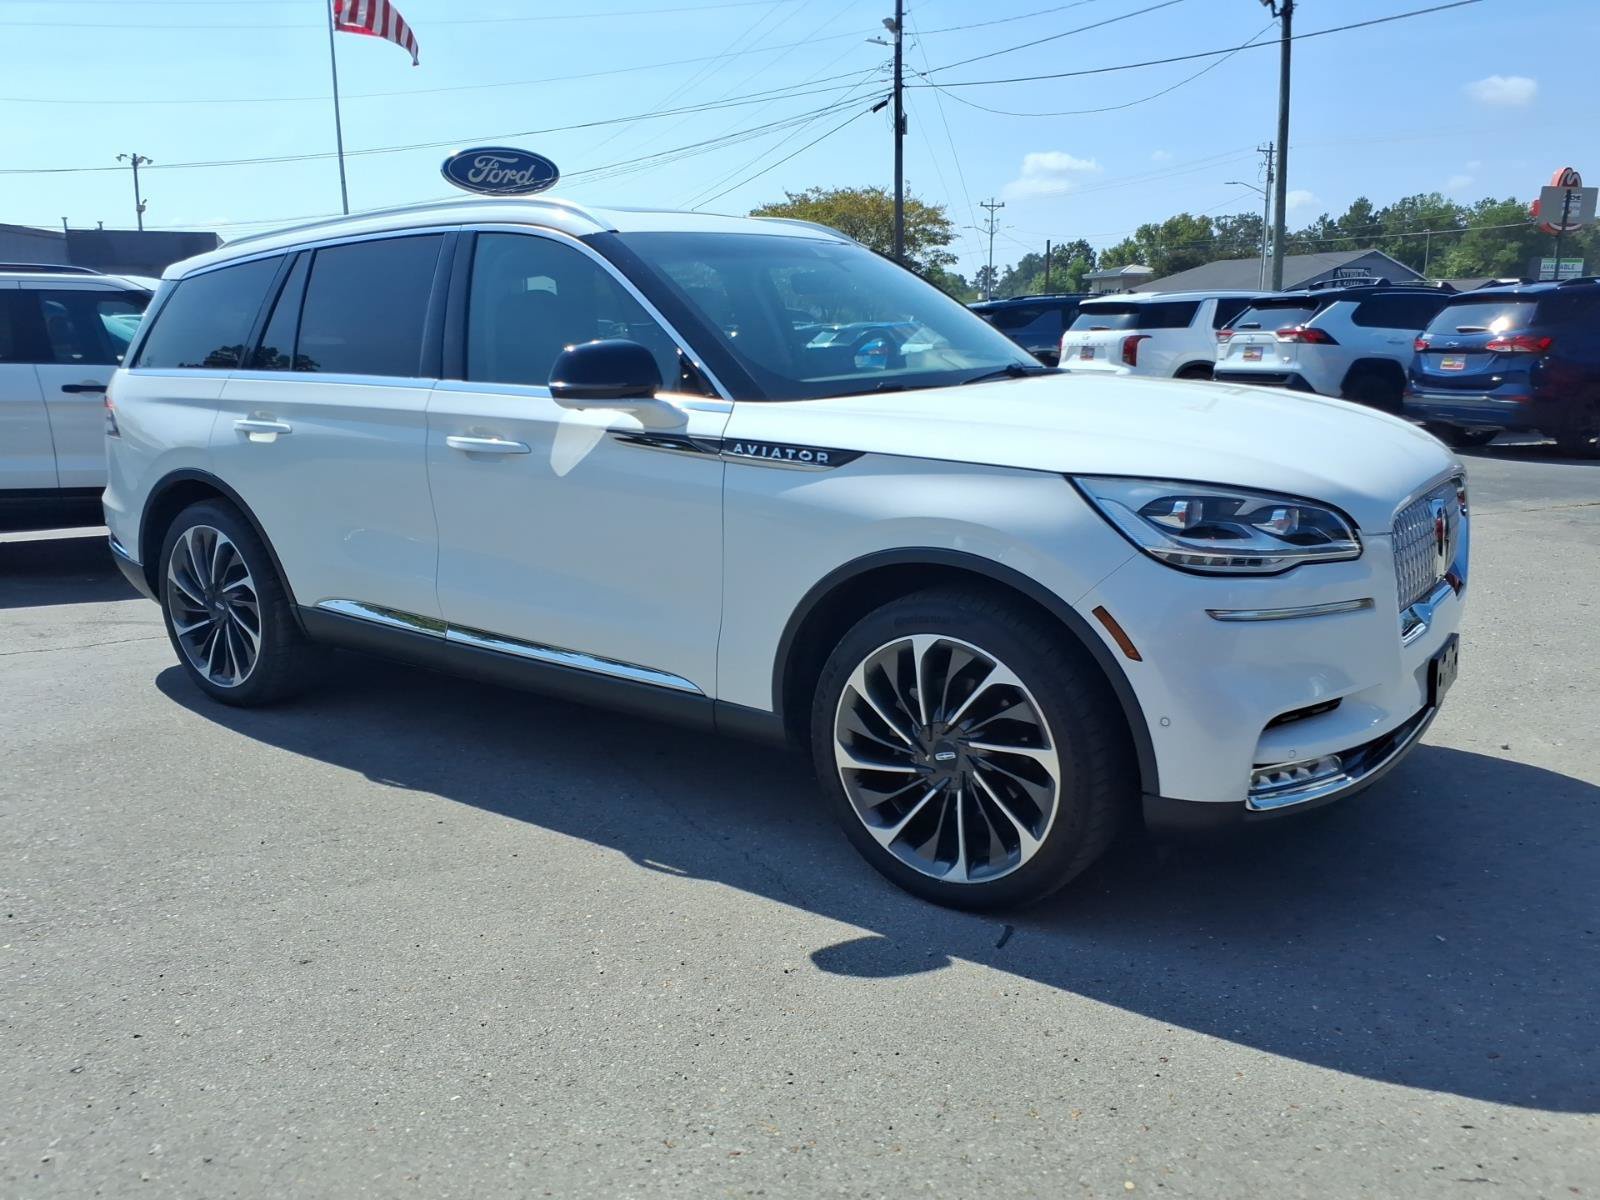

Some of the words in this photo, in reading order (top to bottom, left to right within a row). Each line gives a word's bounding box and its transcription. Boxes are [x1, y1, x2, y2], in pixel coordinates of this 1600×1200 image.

[468, 156, 536, 185] Ford
[1542, 263, 1576, 271] AVAABLE
[734, 443, 828, 463] AVIATOR
